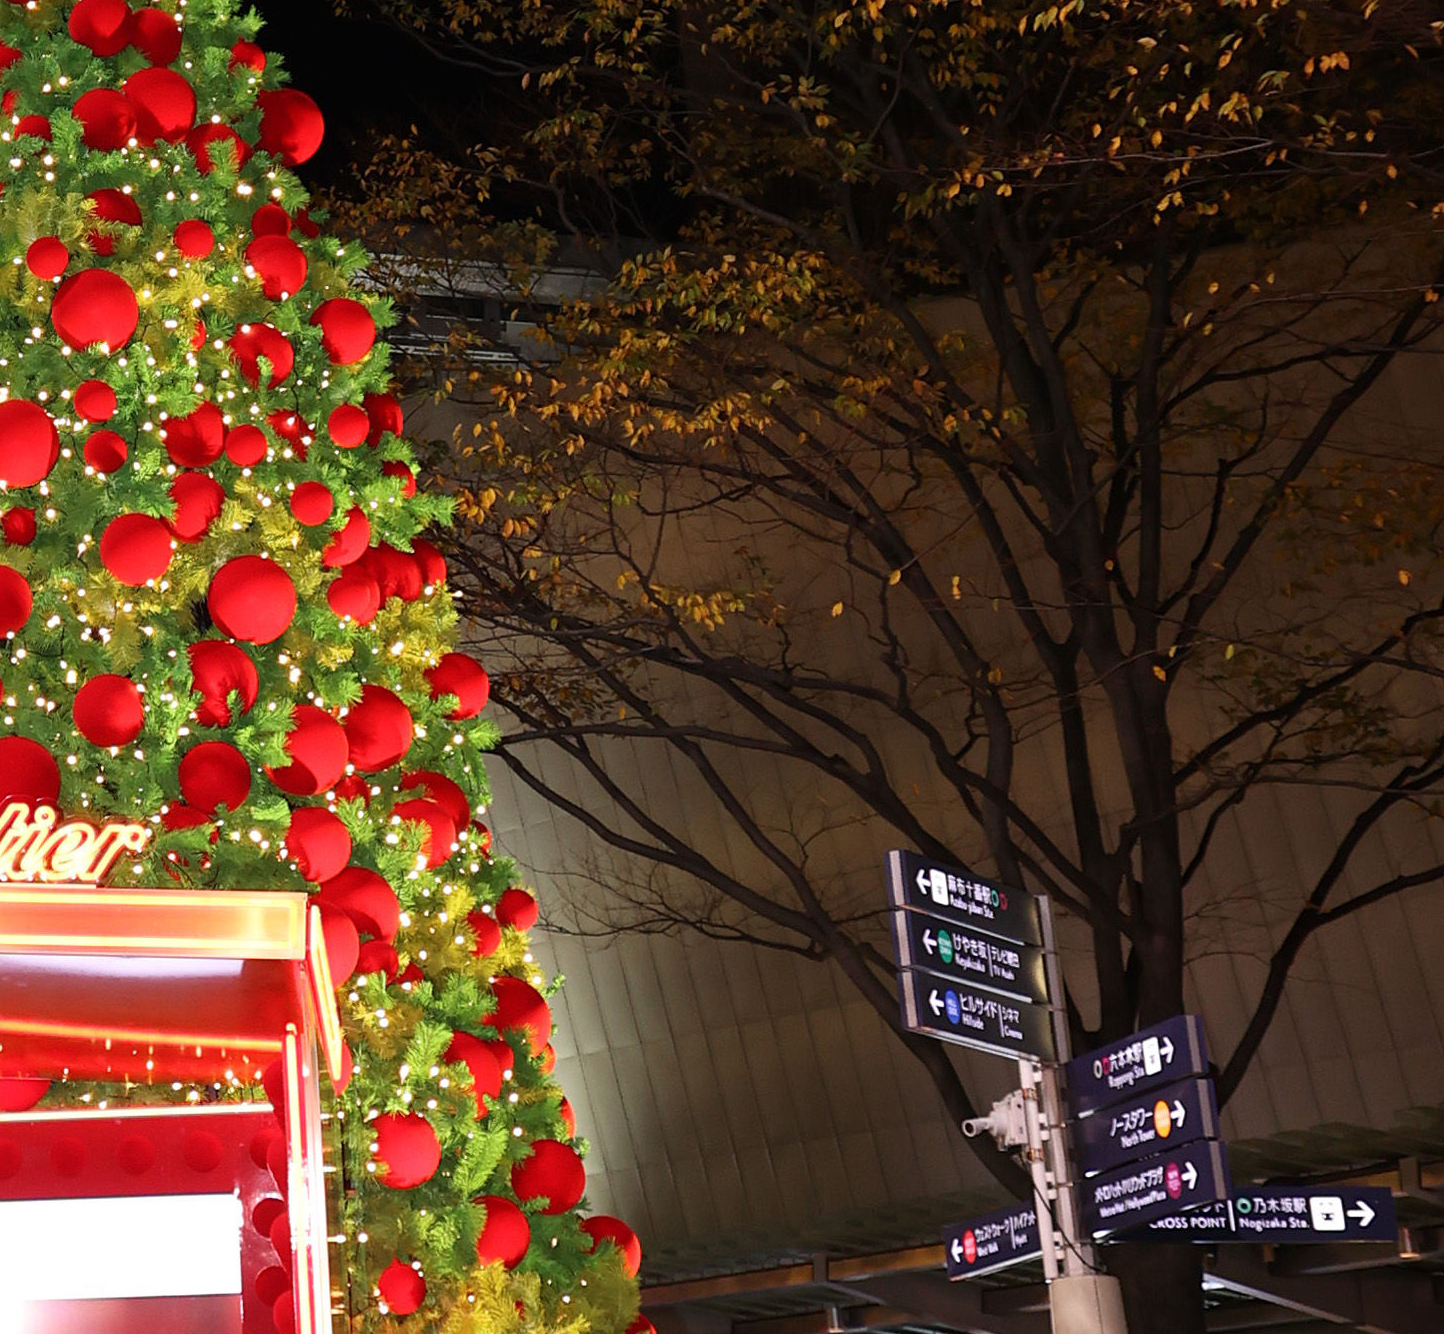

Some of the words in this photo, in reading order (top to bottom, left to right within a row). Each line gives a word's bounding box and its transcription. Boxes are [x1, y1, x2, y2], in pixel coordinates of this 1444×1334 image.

[952, 932, 988, 960] けやき坂
[959, 993, 998, 1019] ヒルサイド
[1002, 1006, 1020, 1024] シネマ
[1110, 1108, 1154, 1137] ノースタワー
[1253, 1197, 1308, 1214] 乃木坂駅
[1190, 1217, 1227, 1229] POINT
[1240, 1217, 1288, 1233] Nogizaka
